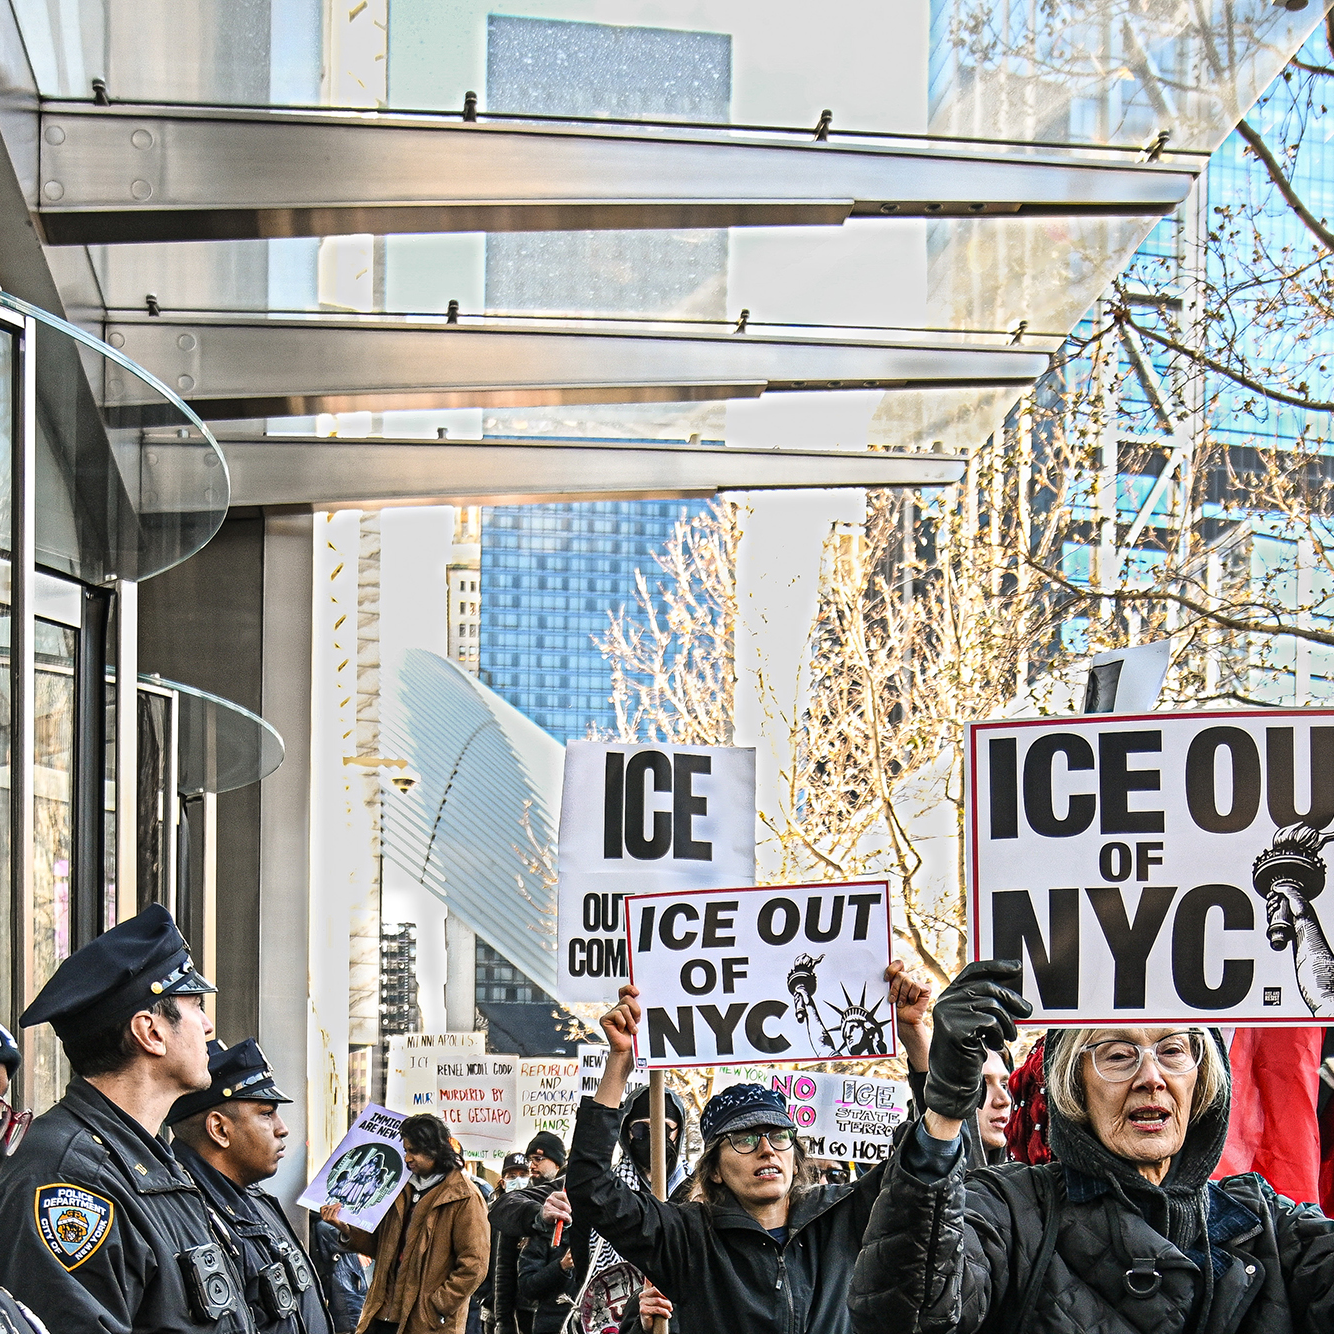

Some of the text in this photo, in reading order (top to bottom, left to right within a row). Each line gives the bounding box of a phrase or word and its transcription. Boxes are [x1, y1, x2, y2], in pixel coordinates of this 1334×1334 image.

[989, 729, 1165, 840] ICE
[604, 750, 712, 861] ICE
[1099, 842, 1164, 882] OF
[638, 894, 882, 952] ICE OUT
[569, 938, 628, 977] COM
[680, 957, 749, 996] OF
[647, 1001, 791, 1058] NYC
[521, 1063, 578, 1076] REPUBLICA
[540, 1077, 561, 1089] AND
[772, 1075, 816, 1101] NO
[439, 1088, 504, 1102] MURDERED BY
[522, 1090, 577, 1102] DEMOCRA
[842, 1080, 894, 1109] ICE
[442, 1109, 511, 1125] ICE GESTAPO
[534, 1119, 570, 1131] HANDS
[836, 1108, 900, 1124] STATE
[836, 1120, 897, 1137] TERRO
[829, 1141, 847, 1156] GO
[43, 1198, 107, 1215] DEPARTMENT
[58, 1189, 93, 1203] POLICE
[41, 1218, 62, 1254] CITY OF
[75, 1220, 107, 1260] NEW YORK
